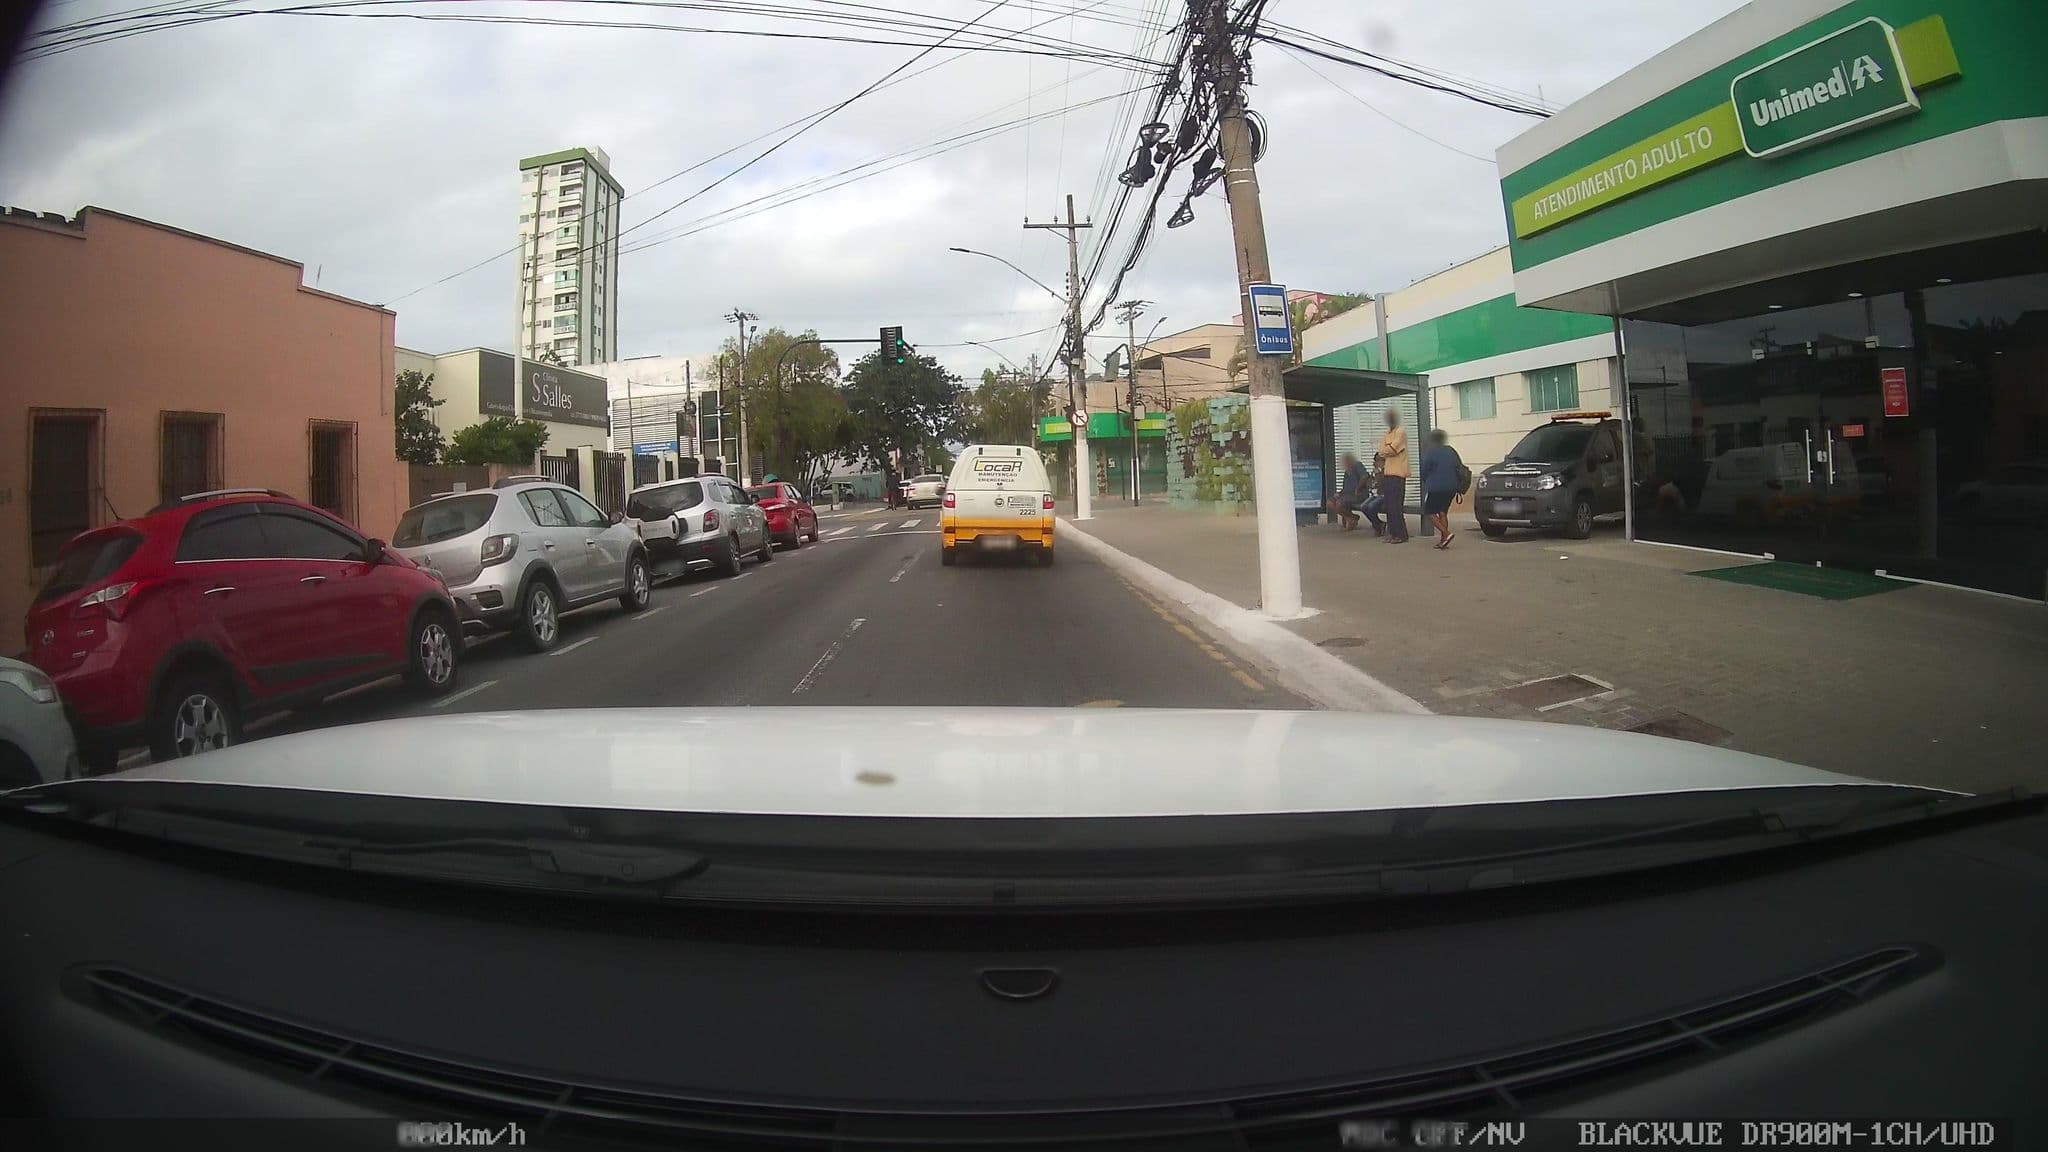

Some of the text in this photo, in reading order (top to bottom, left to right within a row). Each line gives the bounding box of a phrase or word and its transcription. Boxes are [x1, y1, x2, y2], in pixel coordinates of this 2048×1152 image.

[1749, 65, 1846, 128] Unimed
[1532, 125, 1713, 221] ATENDIMENTO ADULTO
[1260, 333, 1288, 344] Ônibus
[531, 372, 541, 402] S
[542, 384, 572, 409] Salles
